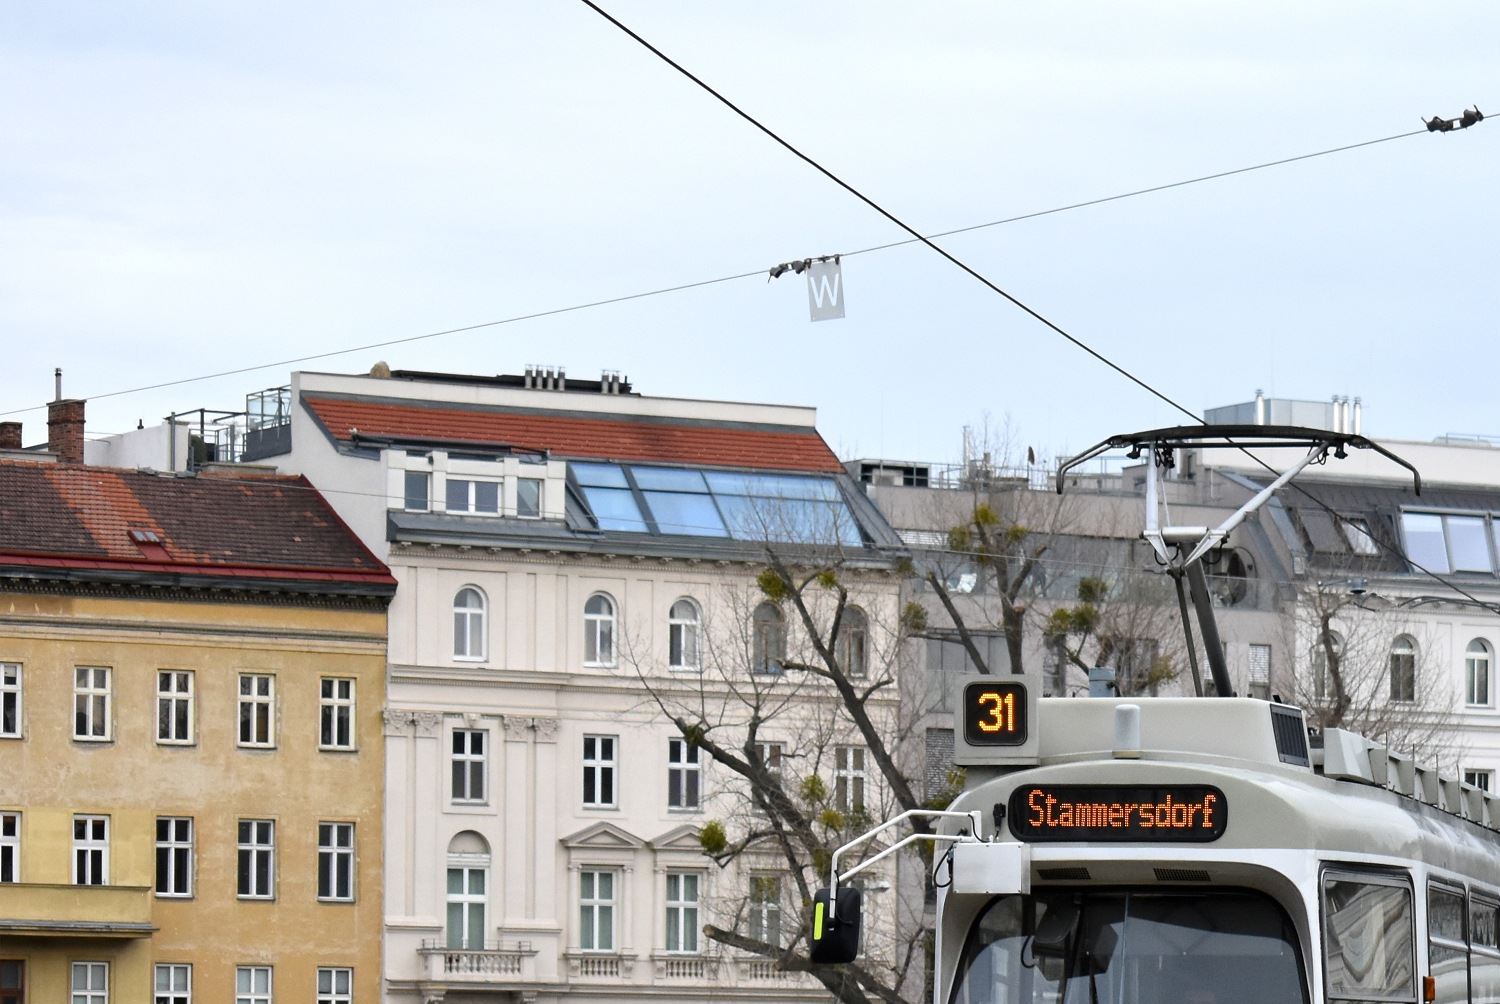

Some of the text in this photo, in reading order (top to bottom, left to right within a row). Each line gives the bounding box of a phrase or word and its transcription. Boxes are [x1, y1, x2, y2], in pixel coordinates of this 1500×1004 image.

[810, 273, 839, 308] W
[978, 692, 1016, 732] 31
[1028, 788, 1217, 829] Stammersdorf
